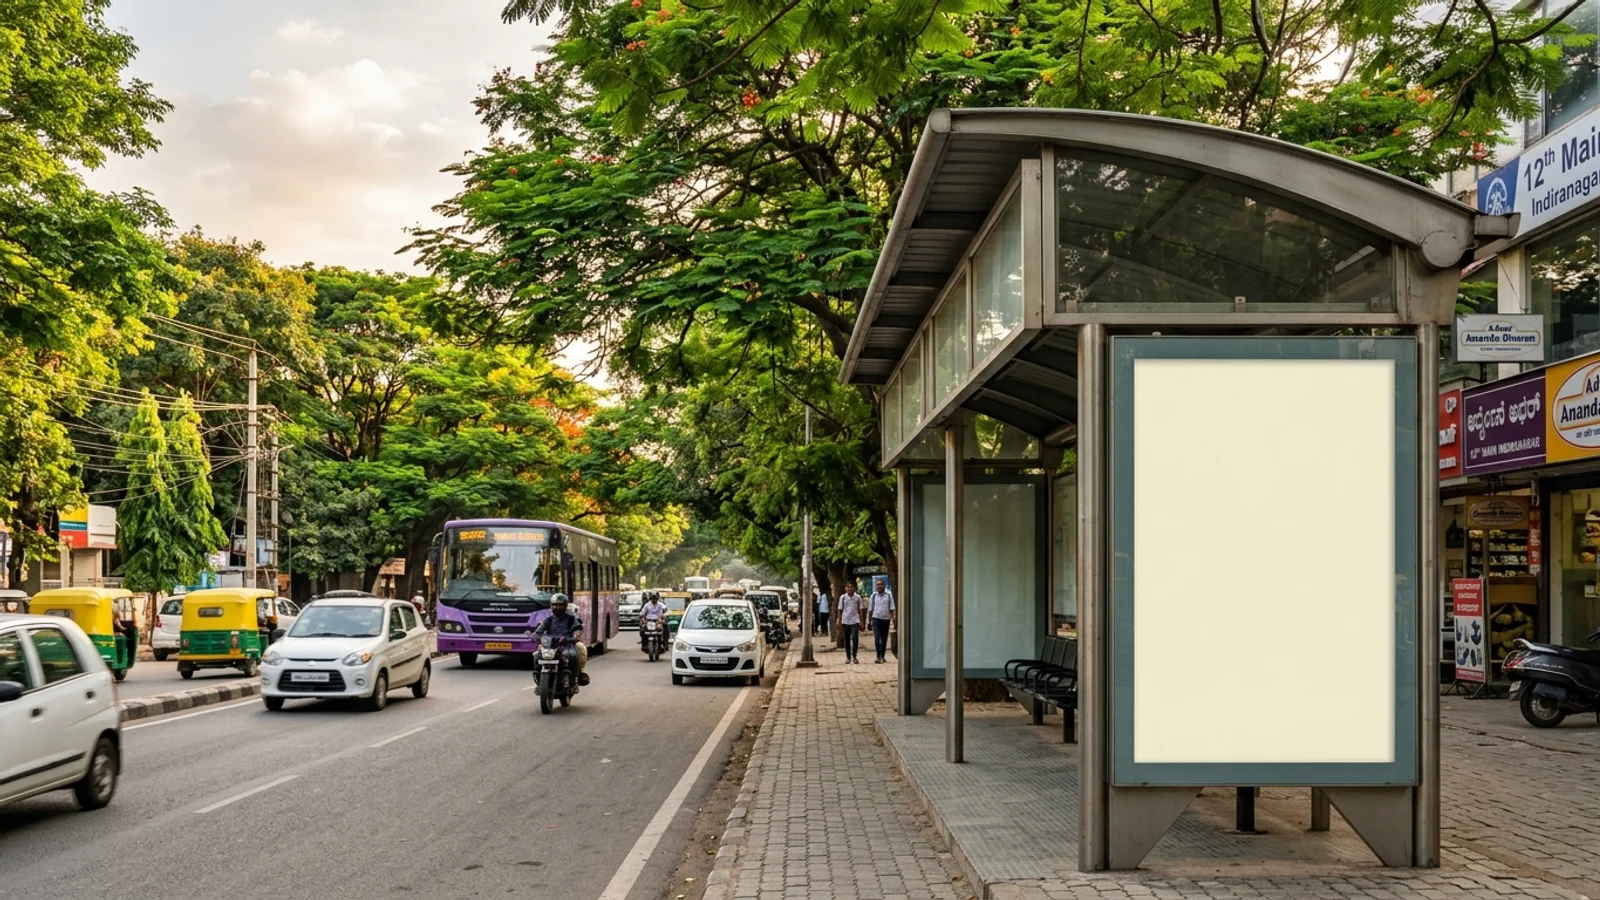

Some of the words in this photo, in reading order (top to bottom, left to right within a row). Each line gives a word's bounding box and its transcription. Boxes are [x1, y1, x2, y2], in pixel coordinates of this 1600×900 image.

[1524, 148, 1555, 192] 12th
[1562, 125, 1600, 173] Mai
[1532, 169, 1600, 216] Indiranaga
[1586, 374, 1600, 394] Ad
